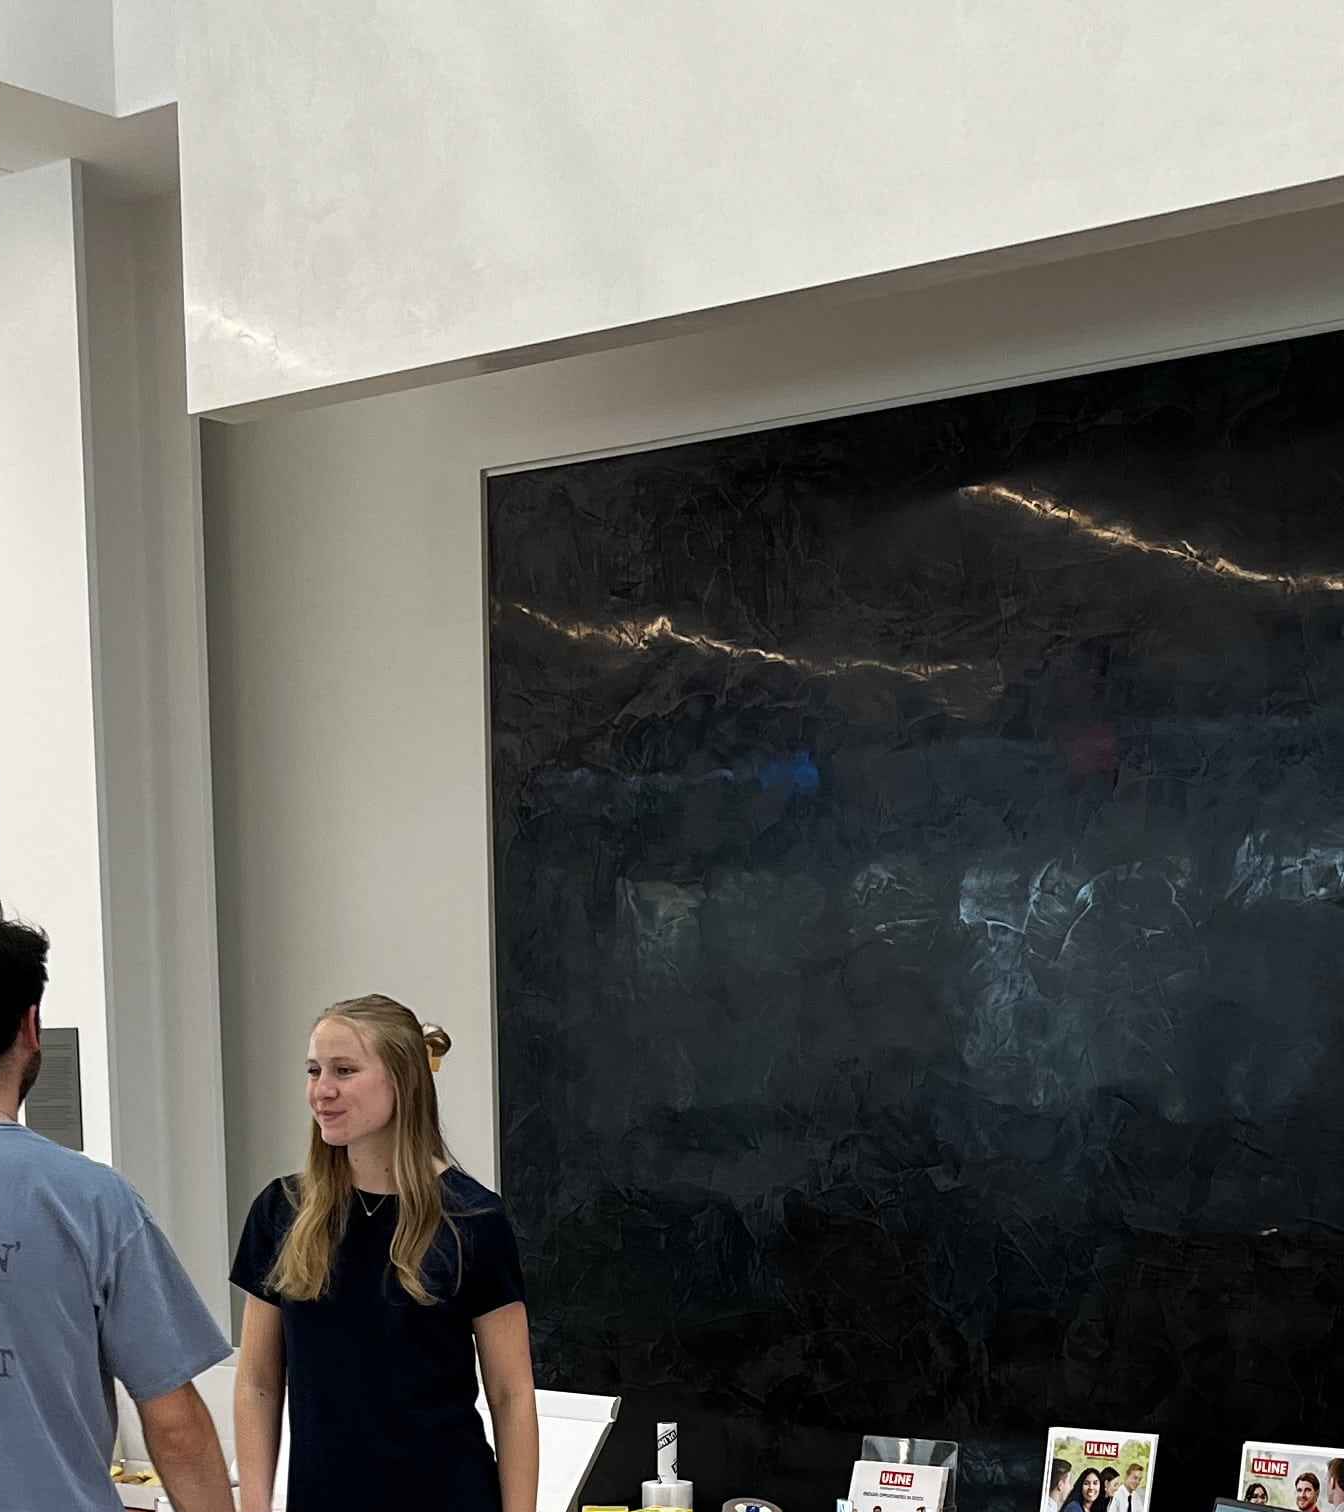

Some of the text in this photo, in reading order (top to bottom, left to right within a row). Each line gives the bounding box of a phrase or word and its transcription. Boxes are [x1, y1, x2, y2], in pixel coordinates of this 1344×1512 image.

[1086, 1443, 1118, 1456] ULINE
[1253, 1460, 1288, 1475] ULINE
[881, 1473, 912, 1486] ULINE
